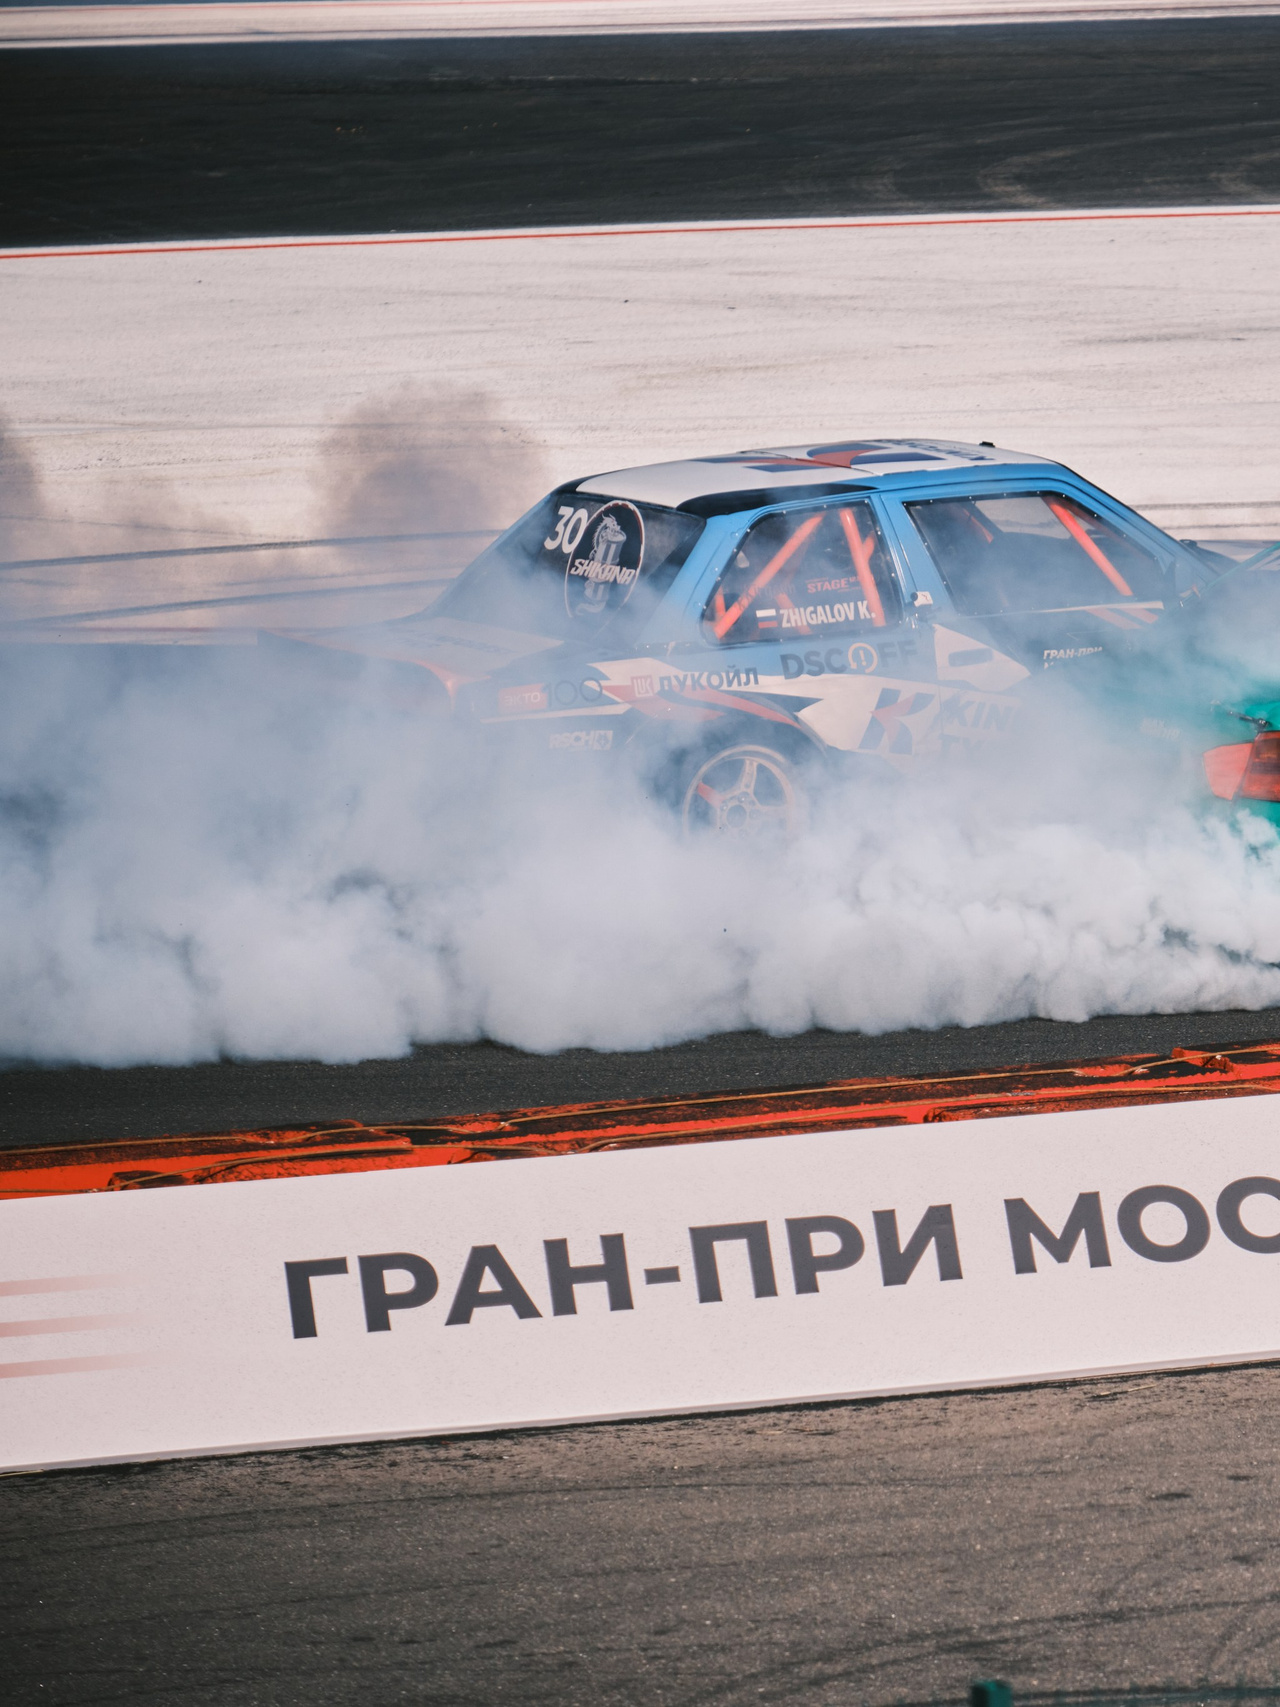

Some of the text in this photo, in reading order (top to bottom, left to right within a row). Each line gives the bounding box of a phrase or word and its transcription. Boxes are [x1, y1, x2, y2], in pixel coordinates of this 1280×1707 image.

[544, 506, 588, 553] 30
[570, 559, 636, 585] SHIKANA
[780, 600, 876, 628] ZHIGALOV K.
[284, 1203, 964, 1340] ГРАН-ПРИ
